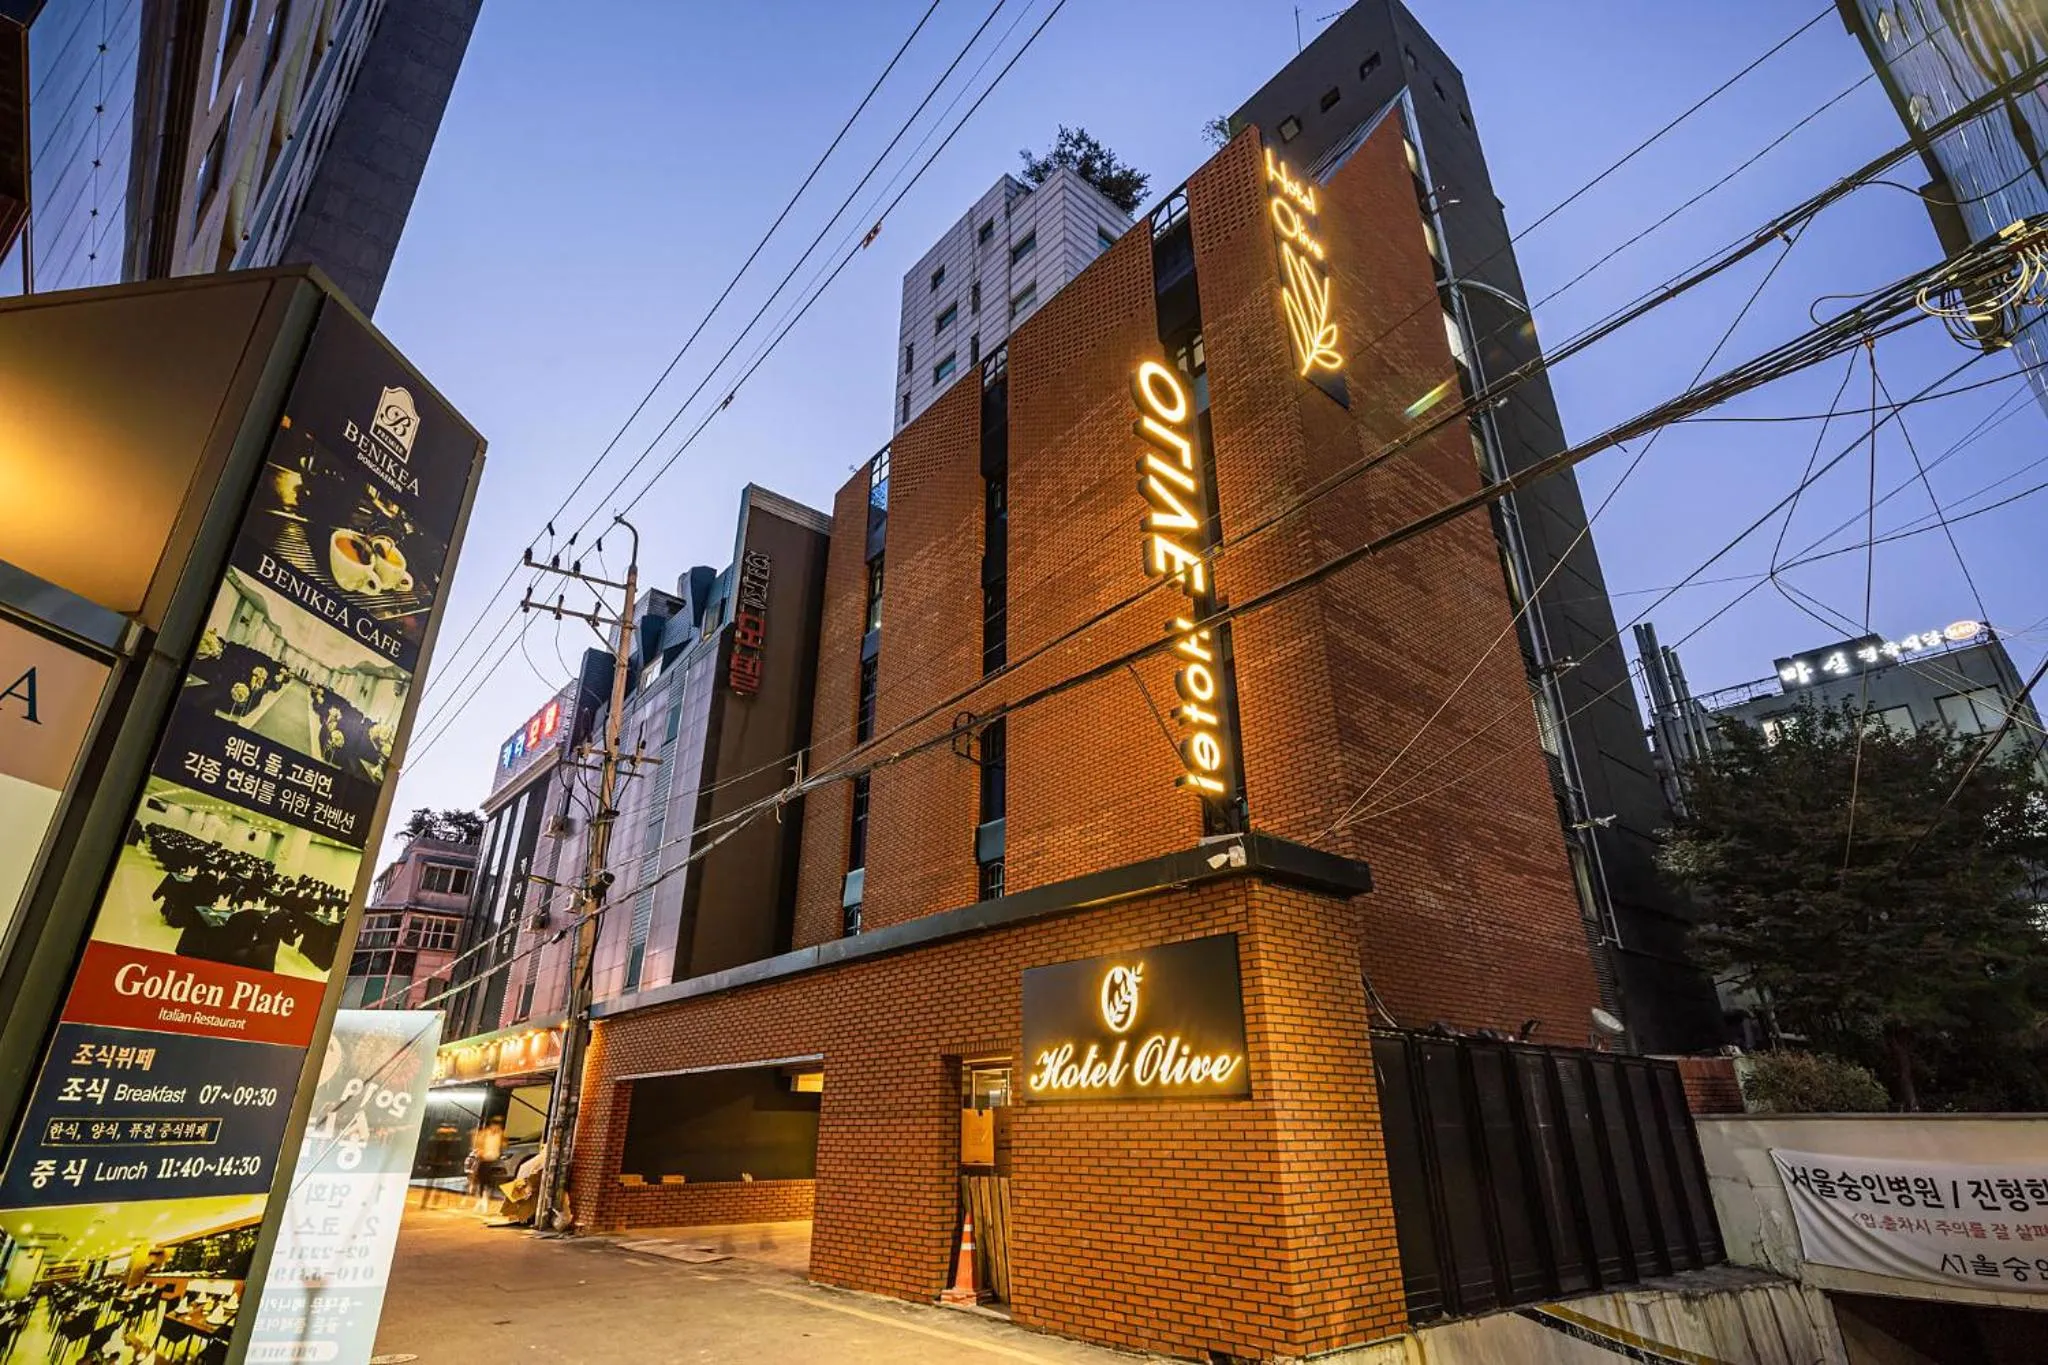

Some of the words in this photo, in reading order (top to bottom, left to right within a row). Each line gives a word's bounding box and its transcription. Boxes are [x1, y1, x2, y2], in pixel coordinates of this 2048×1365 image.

[1266, 148, 1317, 215] Hotel
[1272, 199, 1325, 261] Olive
[344, 419, 420, 496] BENIKEA
[1139, 361, 1205, 593] OLIVE
[1175, 616, 1225, 792] Hotel
[257, 554, 350, 629] BENIKEA
[356, 617, 402, 658] CAFE
[184, 751, 222, 784] 각종
[225, 768, 276, 805] 연회를
[279, 789, 311, 818] 위한
[313, 802, 356, 835] 컨벤션
[224, 736, 262, 771] 웨딩,
[286, 763, 334, 800] 고희연,
[114, 963, 224, 1007] Golden
[228, 980, 295, 1017] Plate
[158, 1006, 191, 1024] Italian
[192, 1011, 247, 1031] Restaurant
[71, 1043, 157, 1071] 조식뷔페
[1029, 1040, 1130, 1092] Hotel
[1132, 1035, 1242, 1087] Olive
[57, 1076, 110, 1104] 조식
[113, 1083, 187, 1104] Breakfast
[199, 1084, 278, 1107] 07~09:30
[50, 1121, 81, 1140] 한식,
[91, 1122, 121, 1141] 양식,
[94, 1161, 148, 1182] Lunch
[157, 1156, 262, 1179] 11:40~14:30
[1790, 1165, 1945, 1209] 서울숭인병원
[1935, 1219, 1988, 1240] 주의를
[1990, 1223, 2012, 1241] 잘
